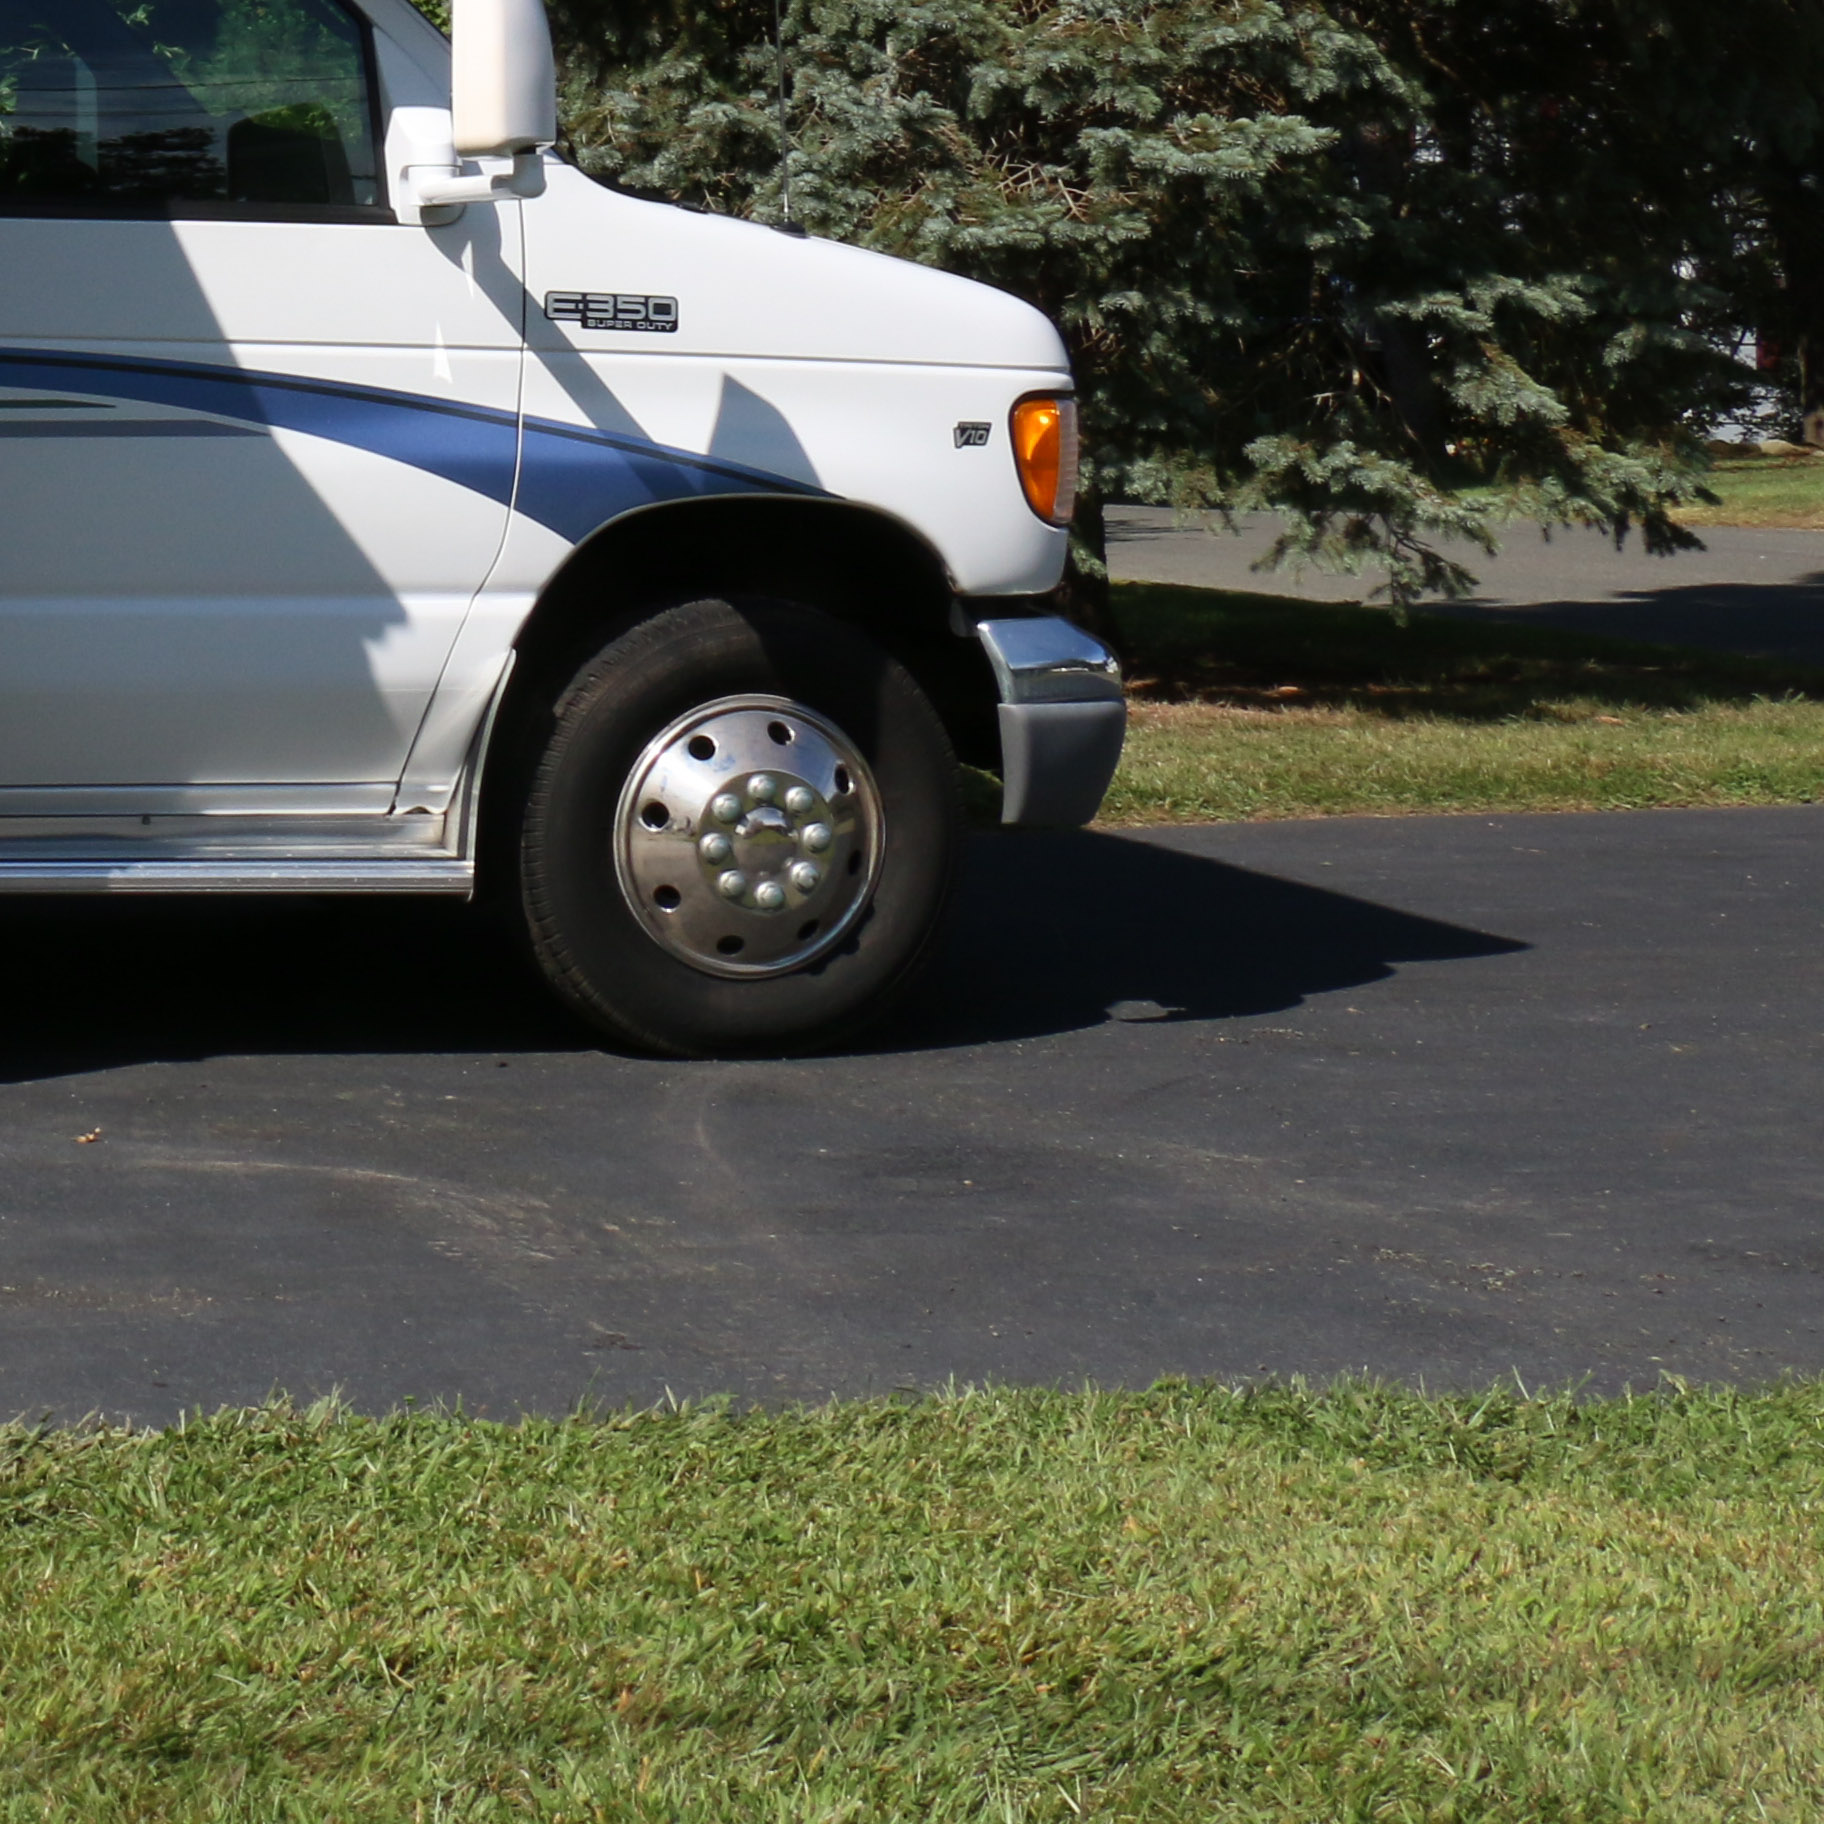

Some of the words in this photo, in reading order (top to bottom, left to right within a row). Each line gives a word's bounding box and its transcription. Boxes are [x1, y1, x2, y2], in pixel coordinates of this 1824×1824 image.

[587, 319, 632, 329] SUPER
[637, 321, 673, 330] DUTY
[955, 428, 987, 448] V10
